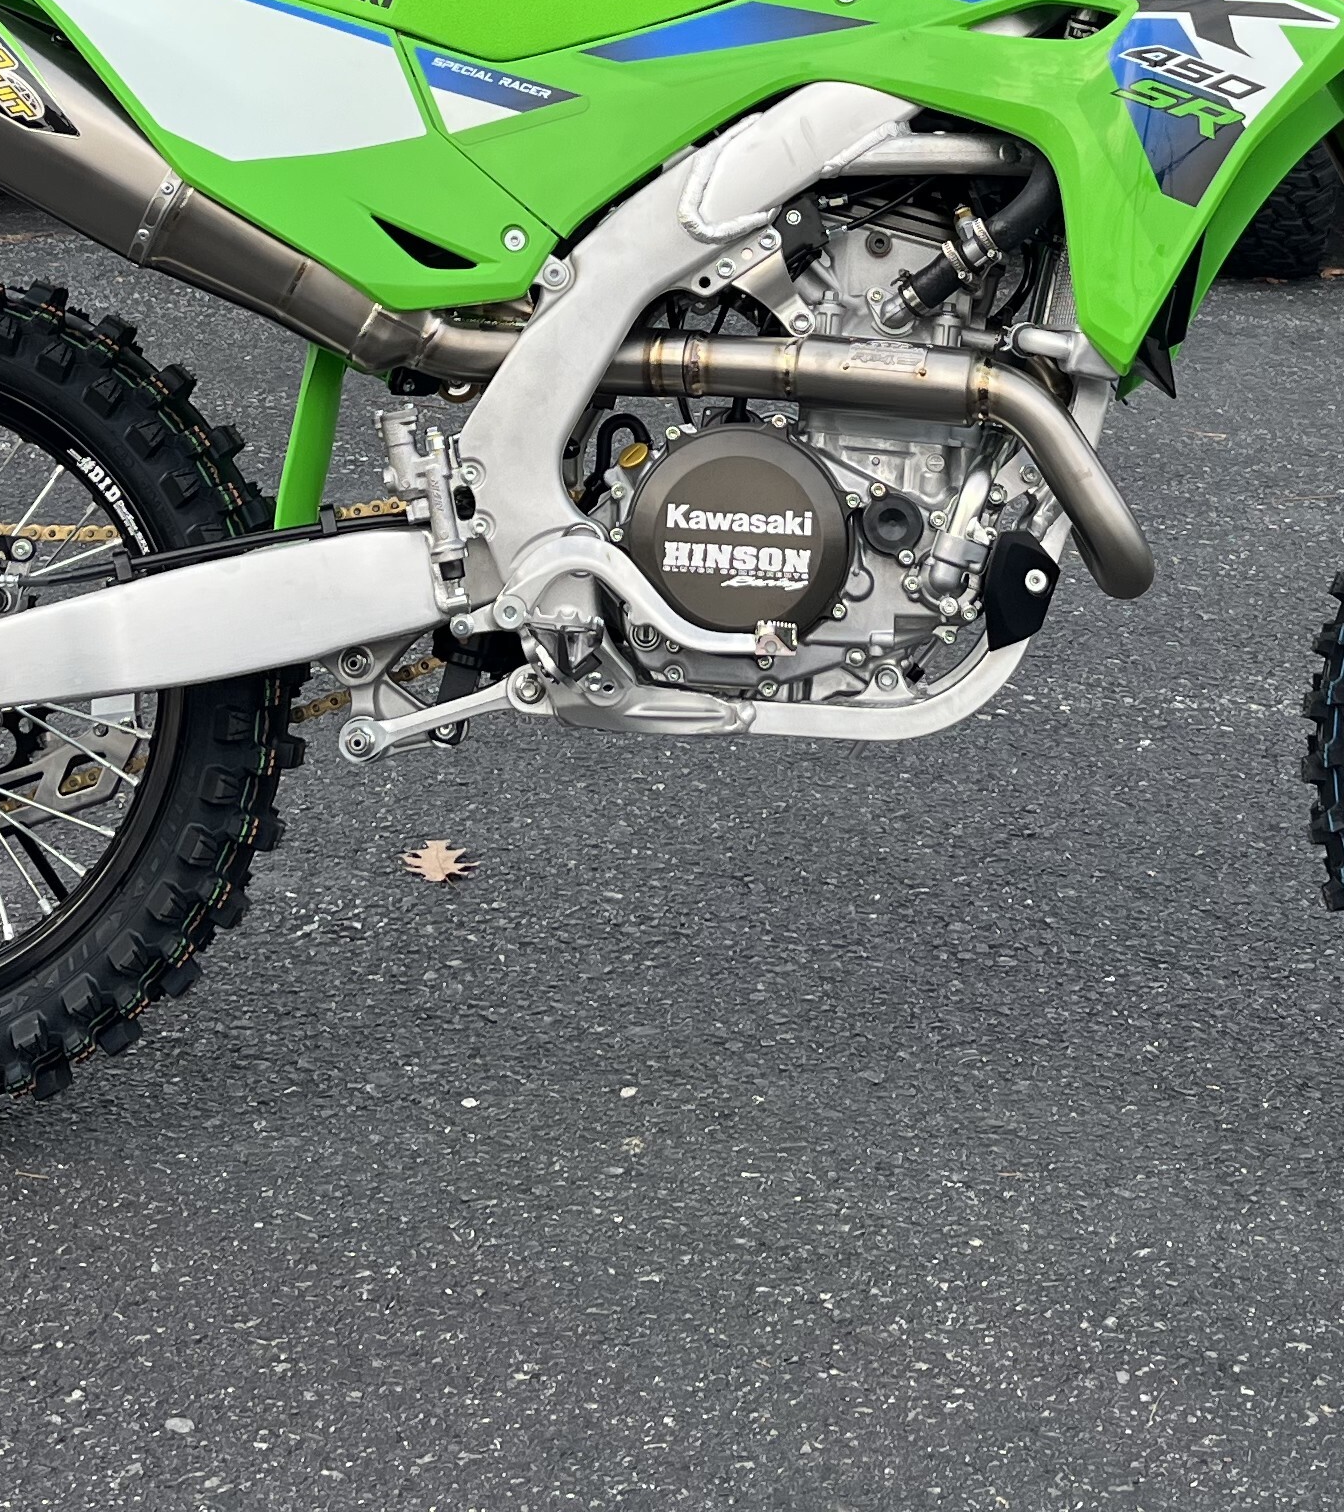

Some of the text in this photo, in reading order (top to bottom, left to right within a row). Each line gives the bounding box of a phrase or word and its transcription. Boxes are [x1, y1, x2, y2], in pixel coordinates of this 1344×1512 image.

[431, 57, 553, 100] SPECIAL RACER
[1118, 44, 1266, 100] 450
[1110, 78, 1247, 140] SR
[666, 502, 812, 536] Kawasaki
[662, 540, 812, 573] HINSON
